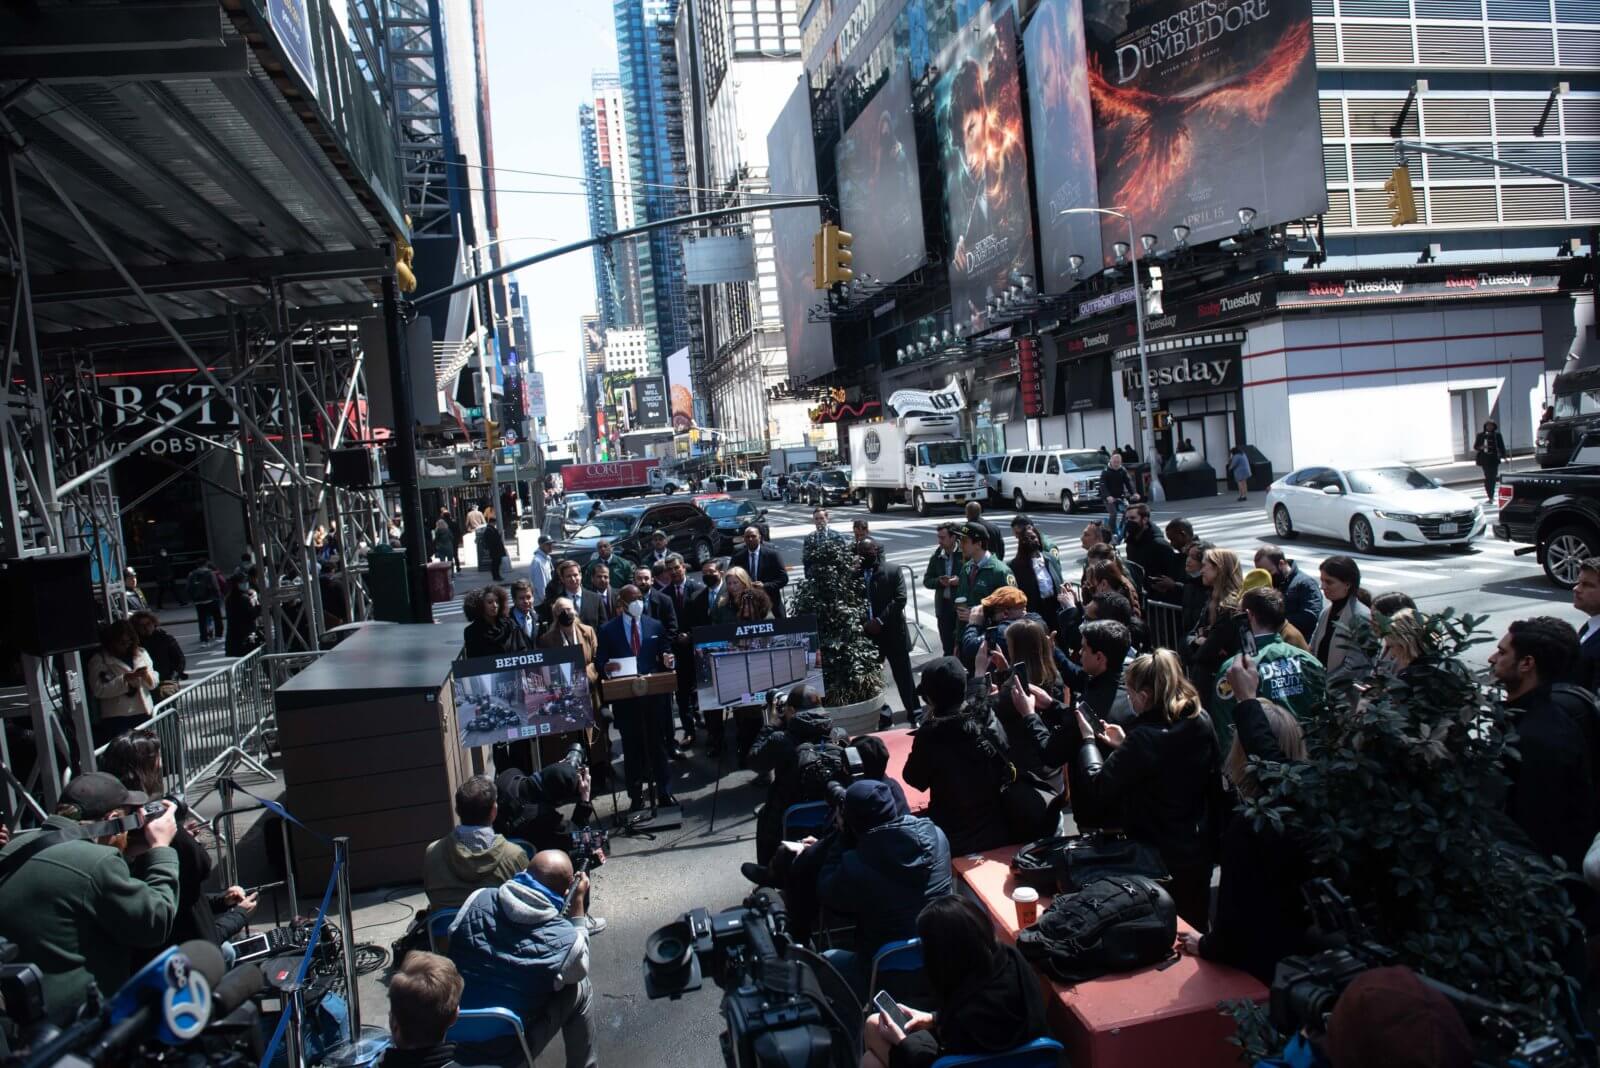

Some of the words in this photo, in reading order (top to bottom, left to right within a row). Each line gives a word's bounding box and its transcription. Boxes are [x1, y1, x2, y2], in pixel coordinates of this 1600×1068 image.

[1150, 0, 1217, 42] SECRETS
[1114, 0, 1270, 84] DUMBLEDORE
[1308, 279, 1345, 297] Ruby
[1345, 278, 1404, 295] Tuesday
[1446, 274, 1479, 289] Ruby
[1478, 271, 1532, 287] Tuesday
[1220, 291, 1262, 312] Tuesday
[1144, 313, 1178, 332] Tuesday
[1083, 332, 1110, 348] Tuesday
[1122, 358, 1232, 390] Tuesday
[929, 391, 960, 410] LOFT
[586, 464, 619, 476] CORT
[735, 623, 775, 636] AFTER
[495, 653, 544, 669] BEFORE
[1260, 656, 1302, 680] DSNY
[1271, 674, 1301, 689] DEPUTY
